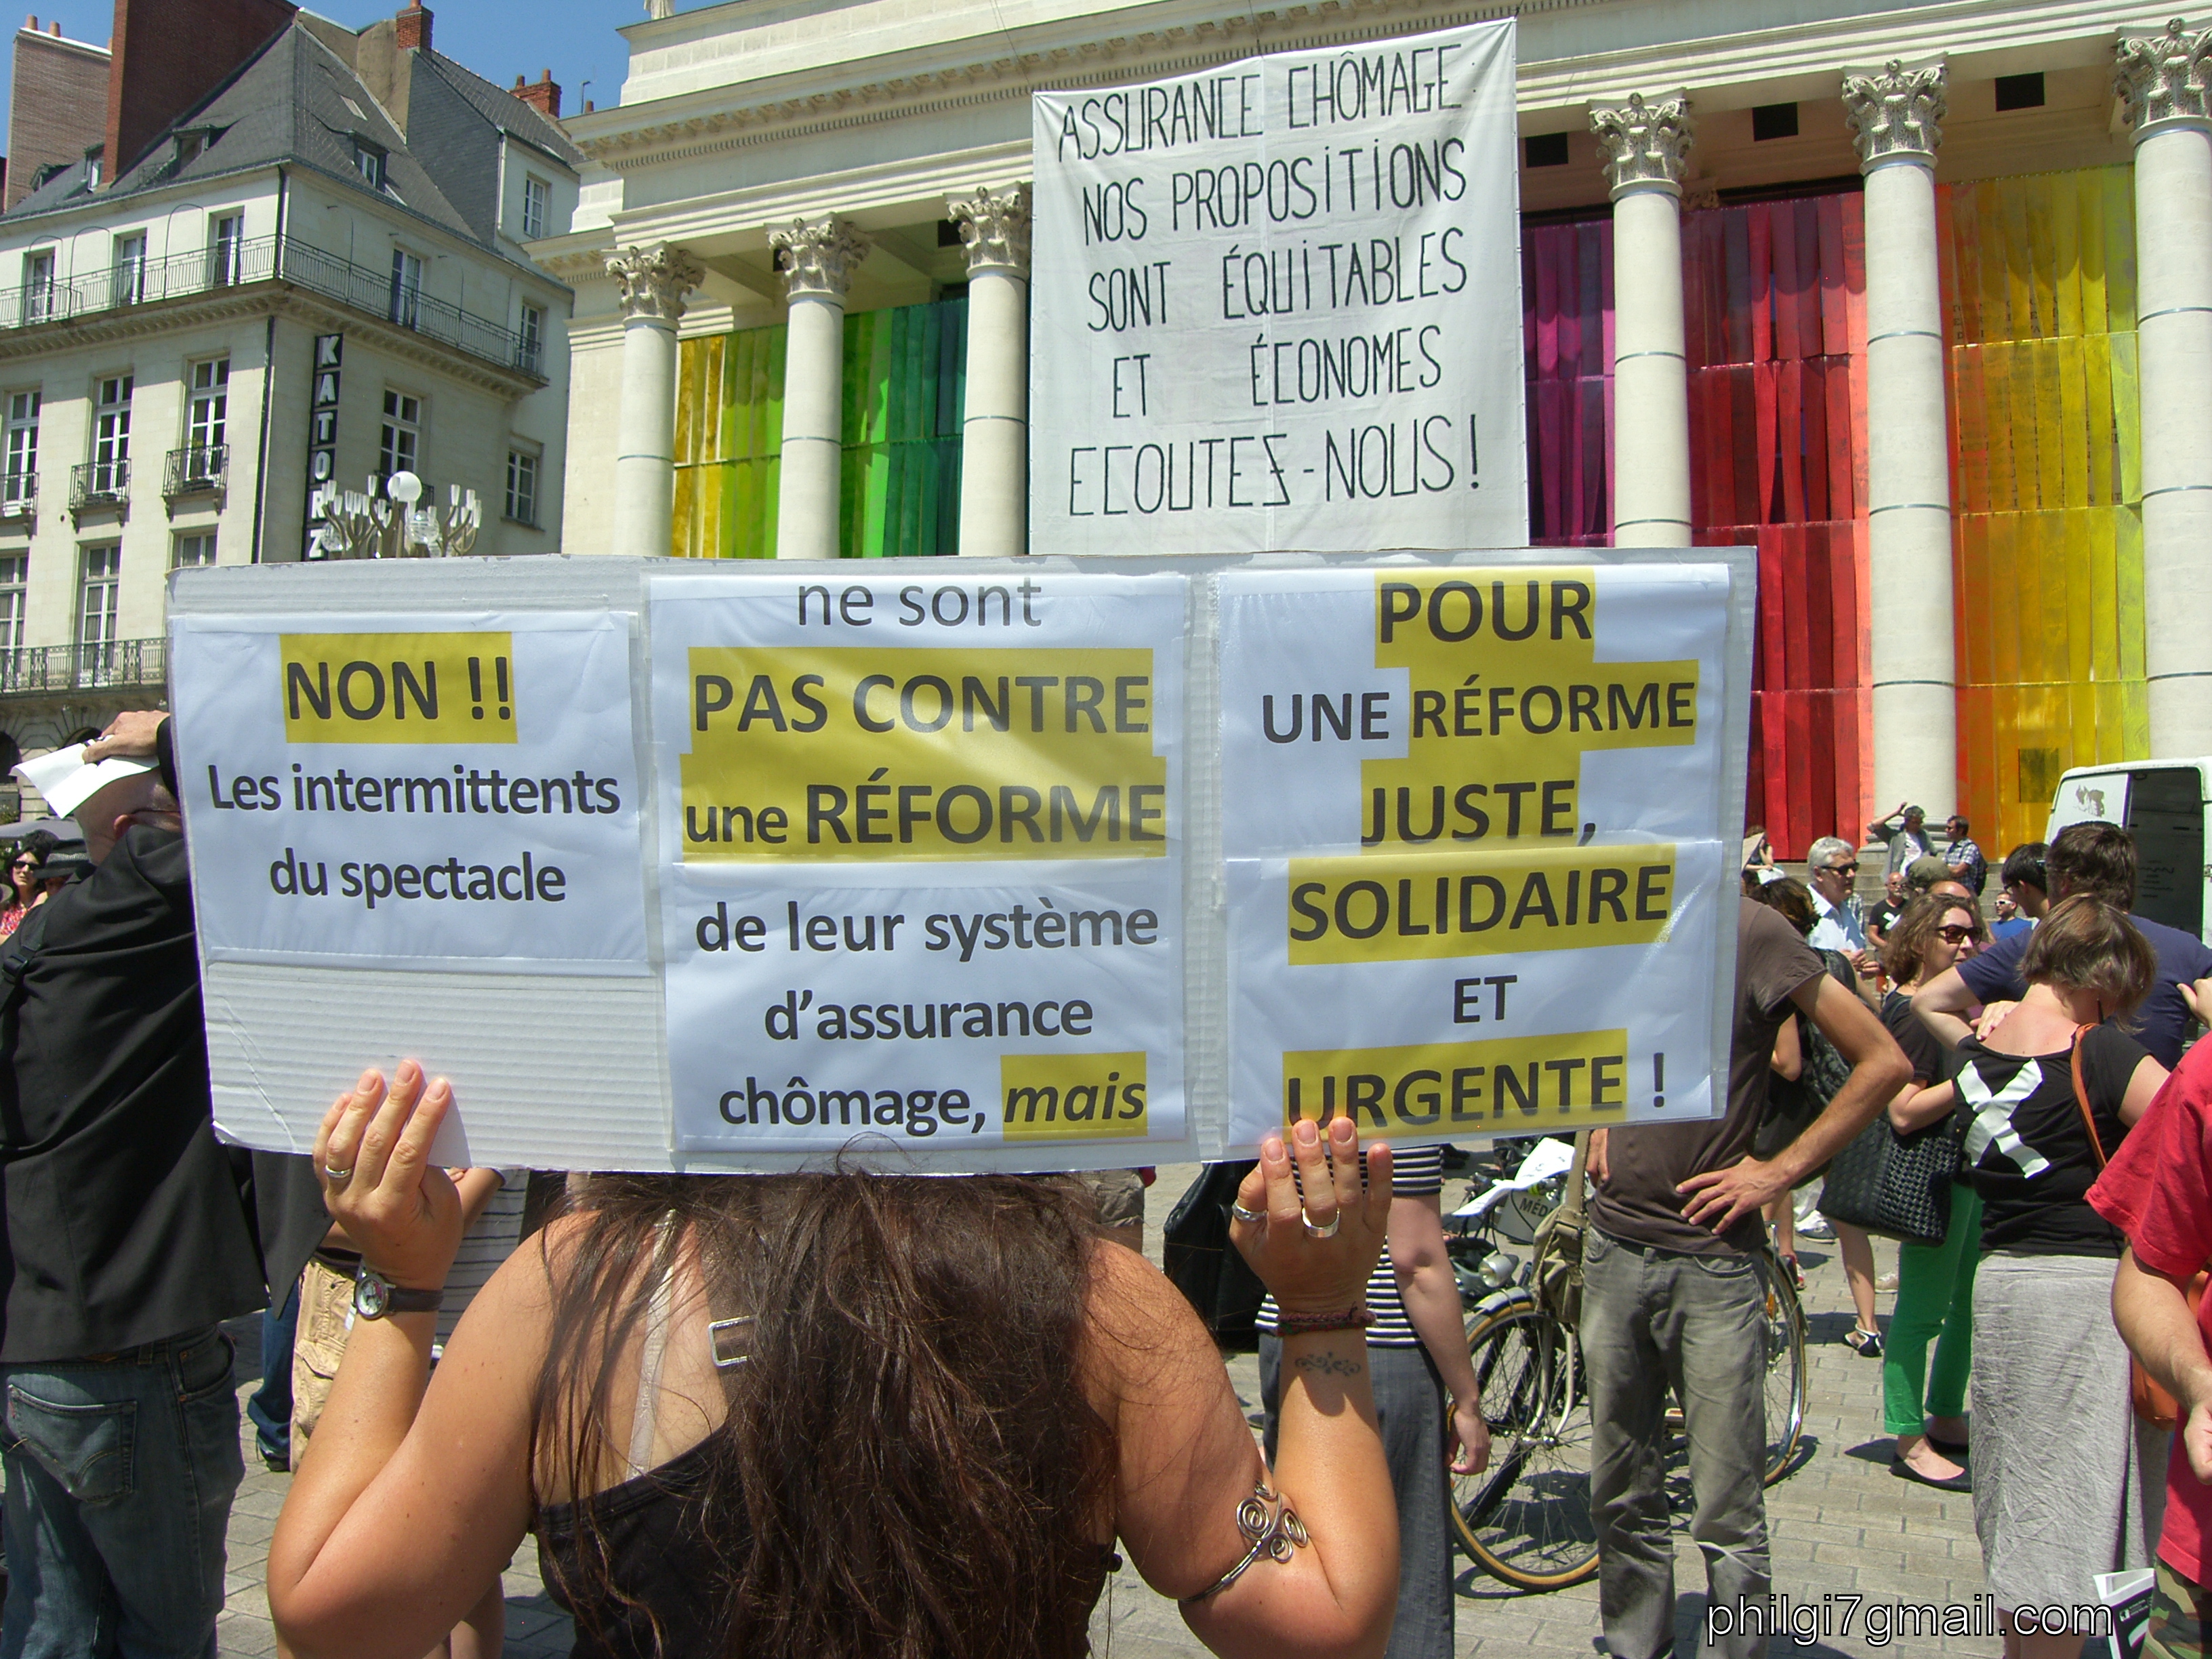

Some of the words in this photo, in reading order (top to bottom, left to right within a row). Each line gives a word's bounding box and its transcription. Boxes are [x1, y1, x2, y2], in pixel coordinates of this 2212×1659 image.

[1058, 73, 1264, 162] ASSURANCE
[1288, 43, 1462, 129] CHÔMAGE
[1084, 178, 1147, 246] NOS
[1088, 262, 1170, 332] SONT
[1113, 354, 1150, 418] ET
[1250, 325, 1441, 406] ÉCONOMES
[799, 586, 874, 626] ne
[899, 577, 1042, 627] sont
[1380, 581, 1591, 643] POUR
[287, 661, 438, 720] NON
[468, 657, 510, 720] !!
[696, 674, 827, 733] PAS
[853, 674, 1149, 733] CONTRE
[1263, 693, 1389, 743] UNE
[1414, 674, 1694, 738] RÉFORME
[208, 765, 281, 811] Les
[292, 764, 620, 814] intermittents
[687, 806, 787, 844] une
[806, 767, 1166, 844] RÉFORME
[1360, 779, 1596, 846] JUSTE,
[270, 848, 327, 895] du
[341, 851, 566, 909] spectacle
[1290, 865, 1671, 941] SOLIDAIRE
[697, 901, 766, 951] de
[788, 901, 904, 951] leur
[925, 897, 1158, 962] système
[765, 989, 1092, 1040] d’assurance
[1454, 975, 1517, 1023] ET
[719, 1076, 985, 1136] chômage,
[1004, 1072, 1145, 1122] mais
[1287, 1054, 1623, 1129] URGENTE
[1654, 1052, 1664, 1107] !
